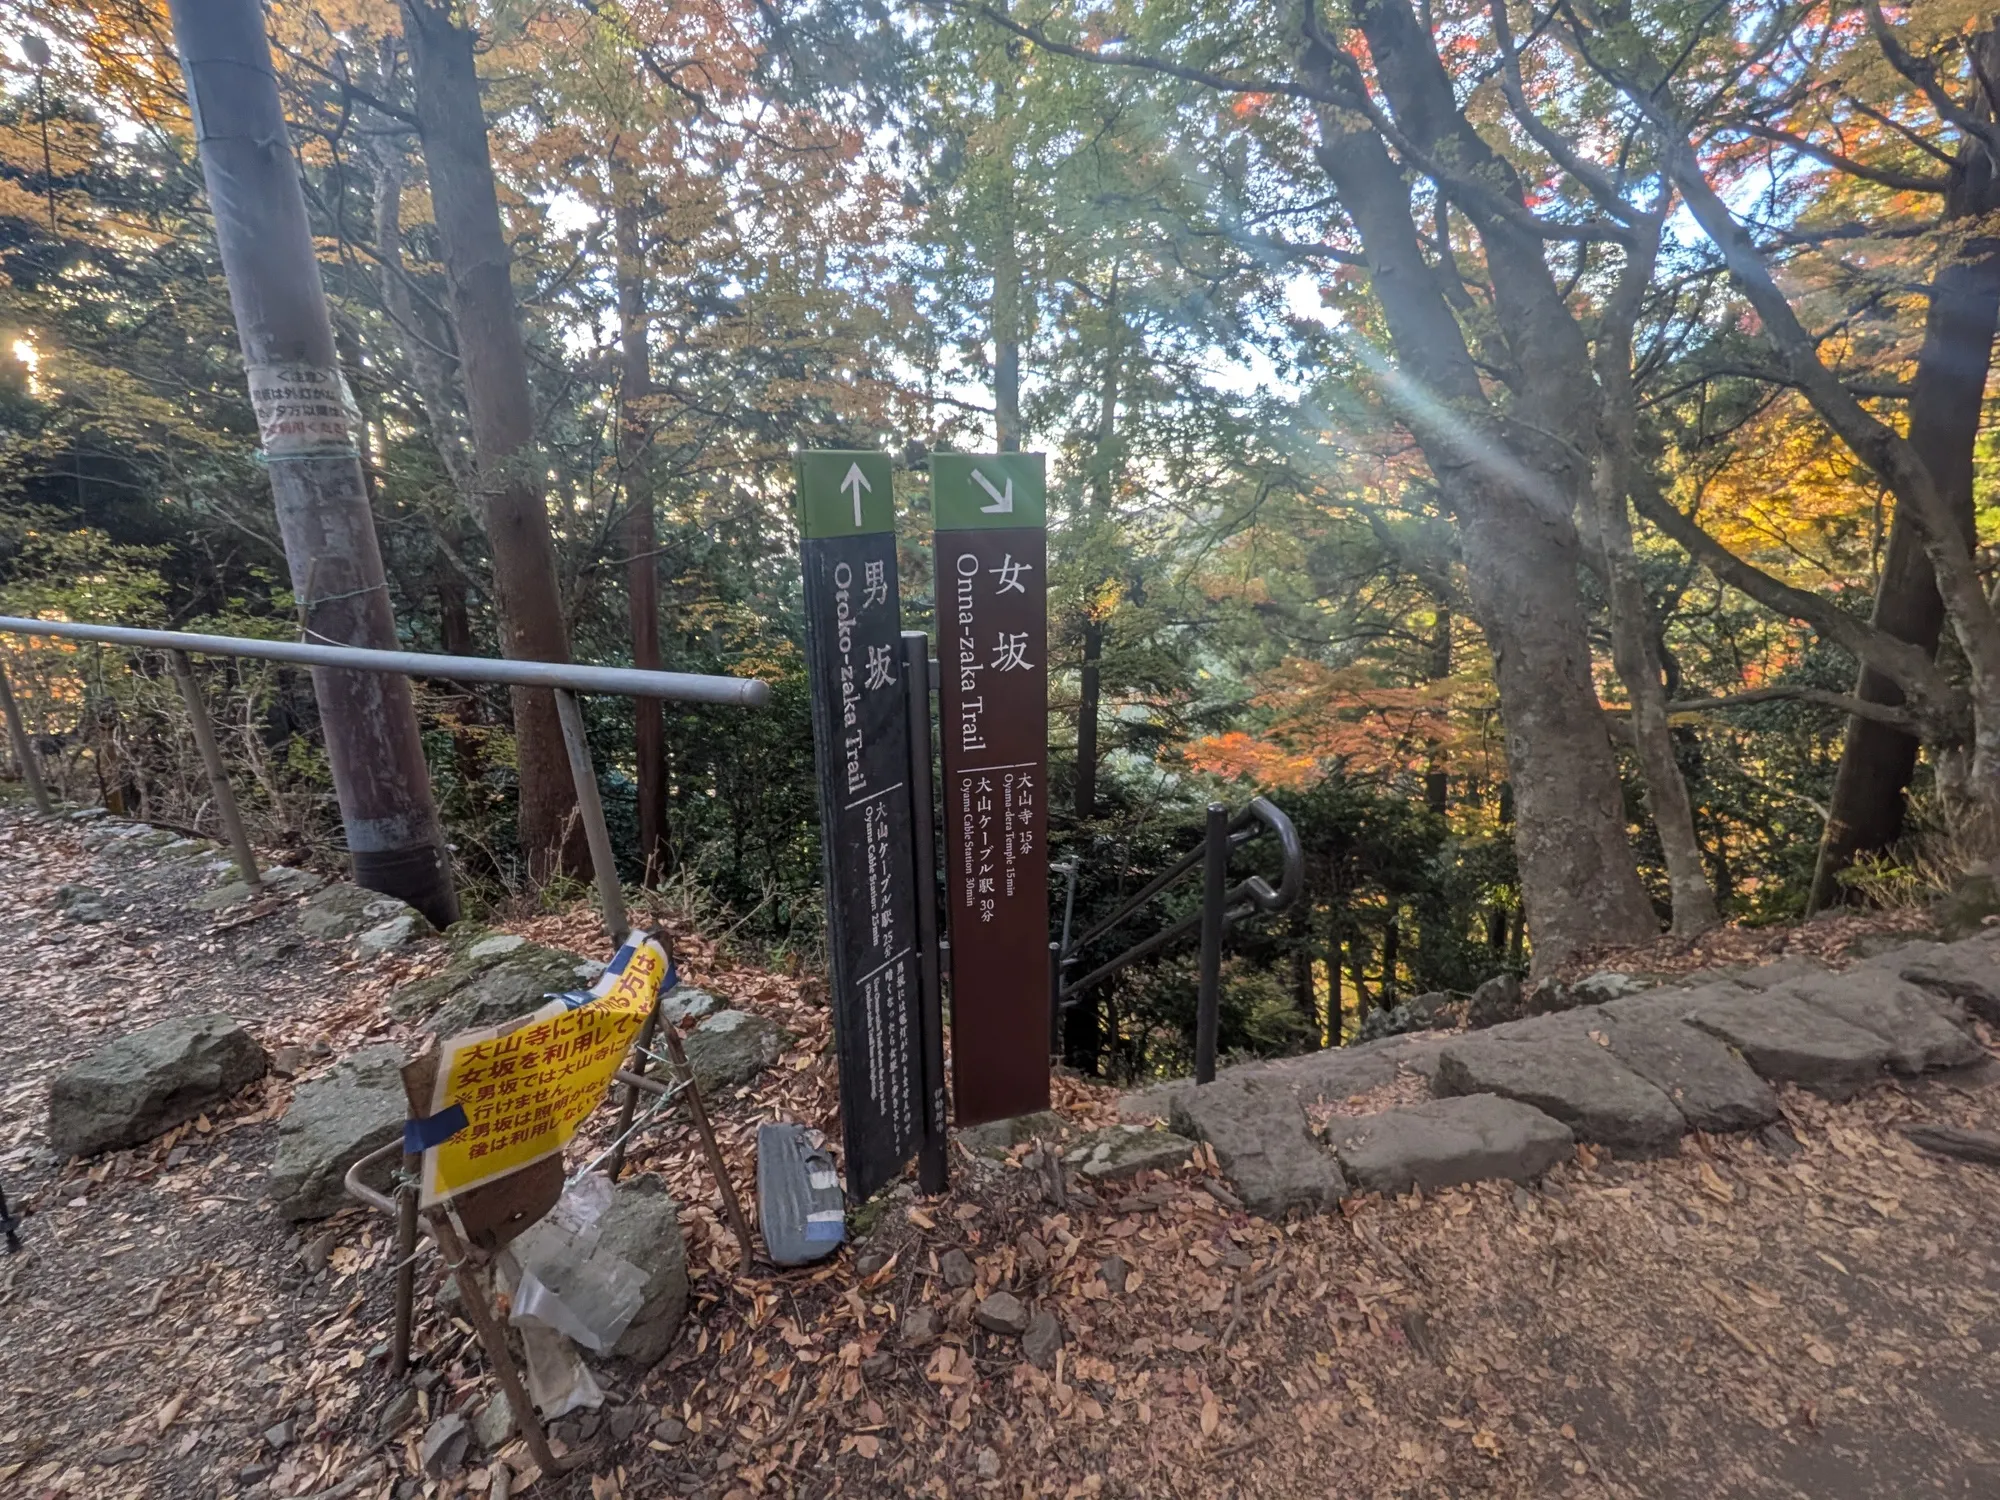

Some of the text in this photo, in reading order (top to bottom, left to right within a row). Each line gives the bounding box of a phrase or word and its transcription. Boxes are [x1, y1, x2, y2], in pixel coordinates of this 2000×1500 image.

[863, 559, 897, 691] 男坂
[956, 553, 987, 752] Onna-zaka Trail
[988, 553, 1035, 672] 女坂
[834, 562, 867, 794] Otoko-zaka Trail
[864, 805, 873, 844] Oyama
[867, 844, 877, 873] Cable
[960, 778, 975, 907] Oyama Cable Station 30min
[975, 776, 995, 894] 大山ケーブル駅
[1003, 773, 1016, 896] Oyama-dera Temple 15min
[1016, 772, 1034, 826] 大山寺
[869, 873, 879, 911] Station
